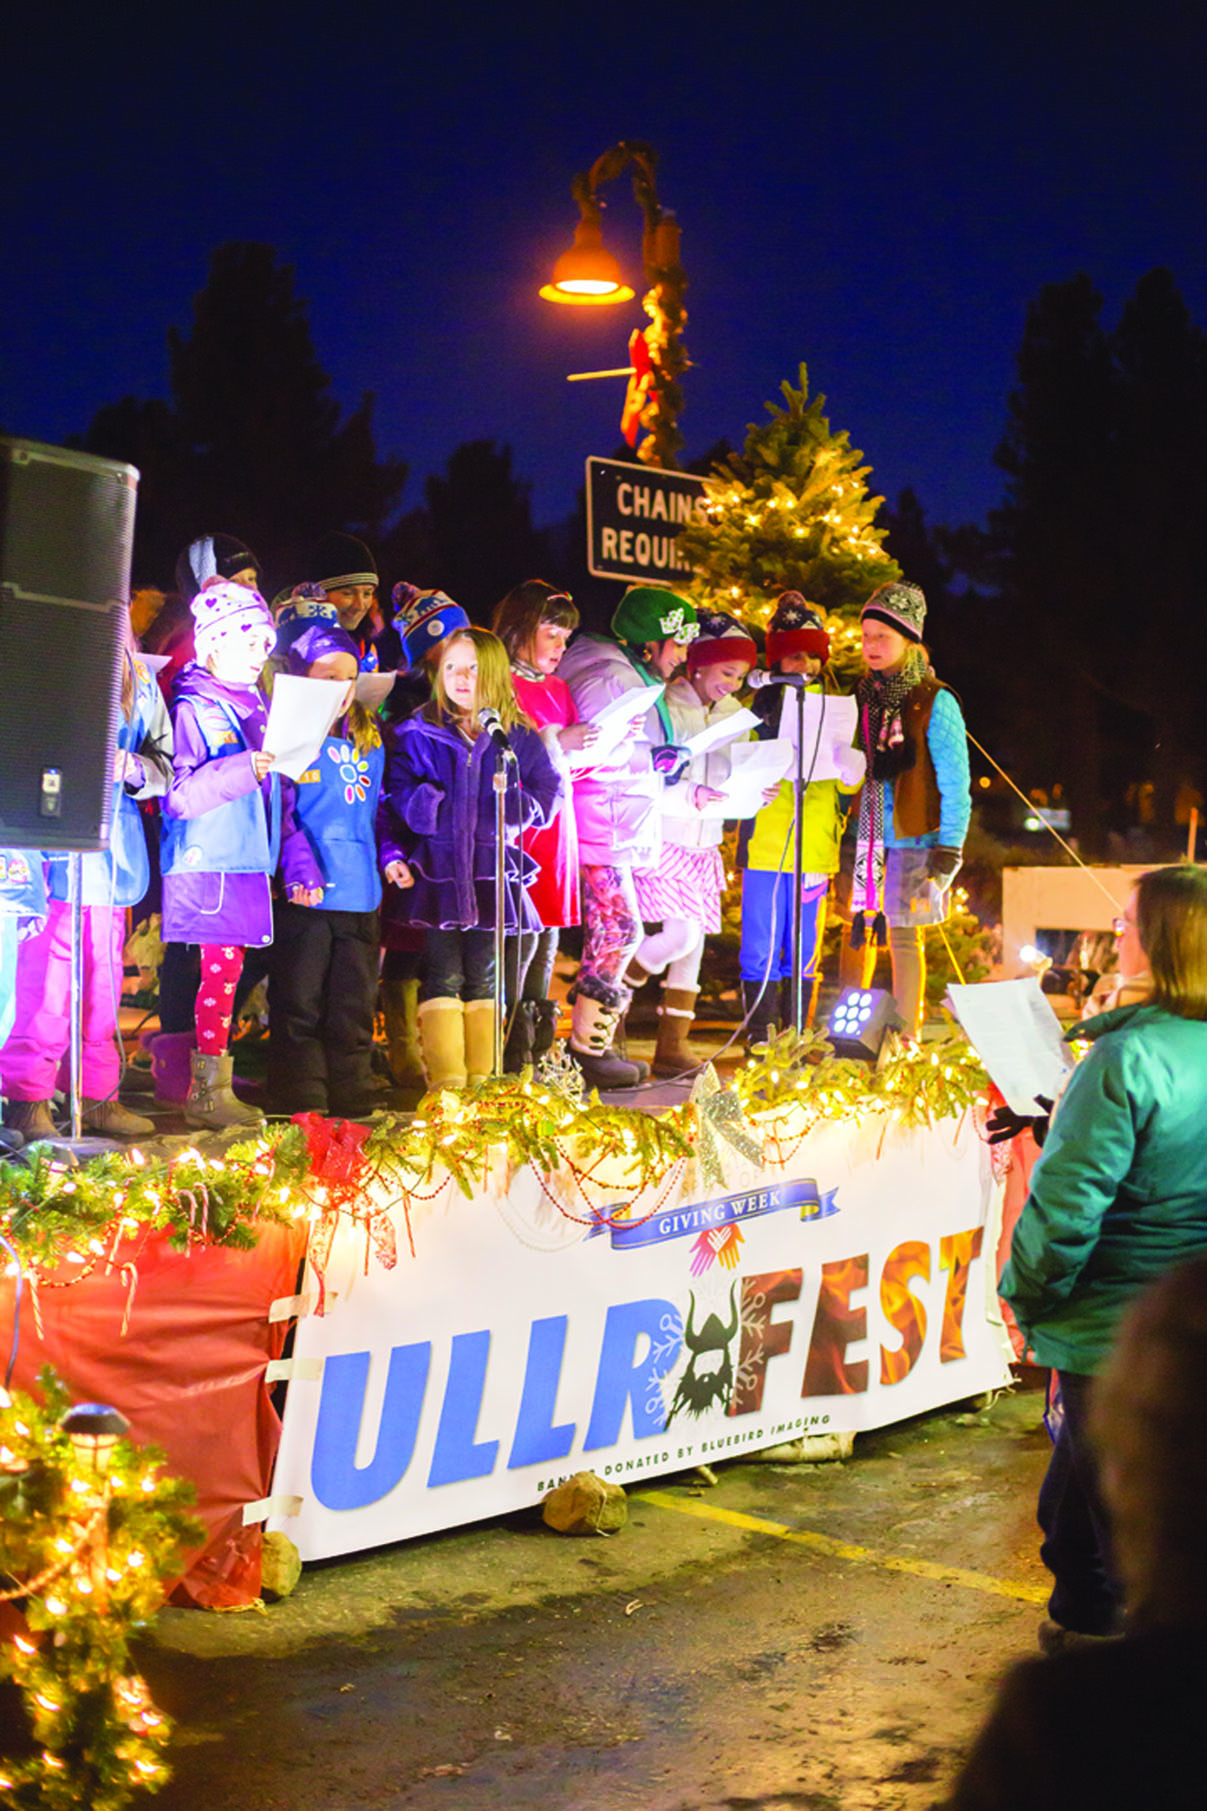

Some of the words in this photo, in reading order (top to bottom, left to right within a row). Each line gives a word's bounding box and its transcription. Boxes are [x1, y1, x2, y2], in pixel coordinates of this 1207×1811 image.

[659, 1203, 726, 1234] GIVING
[730, 1190, 783, 1216] WEEK
[311, 1298, 684, 1511] ULLR
[728, 1226, 985, 1418] FEST
[604, 1451, 670, 1476] DONATED
[677, 1445, 694, 1459] BY
[701, 1429, 764, 1453] BLUEBIRD
[770, 1414, 831, 1436] IMAGING
